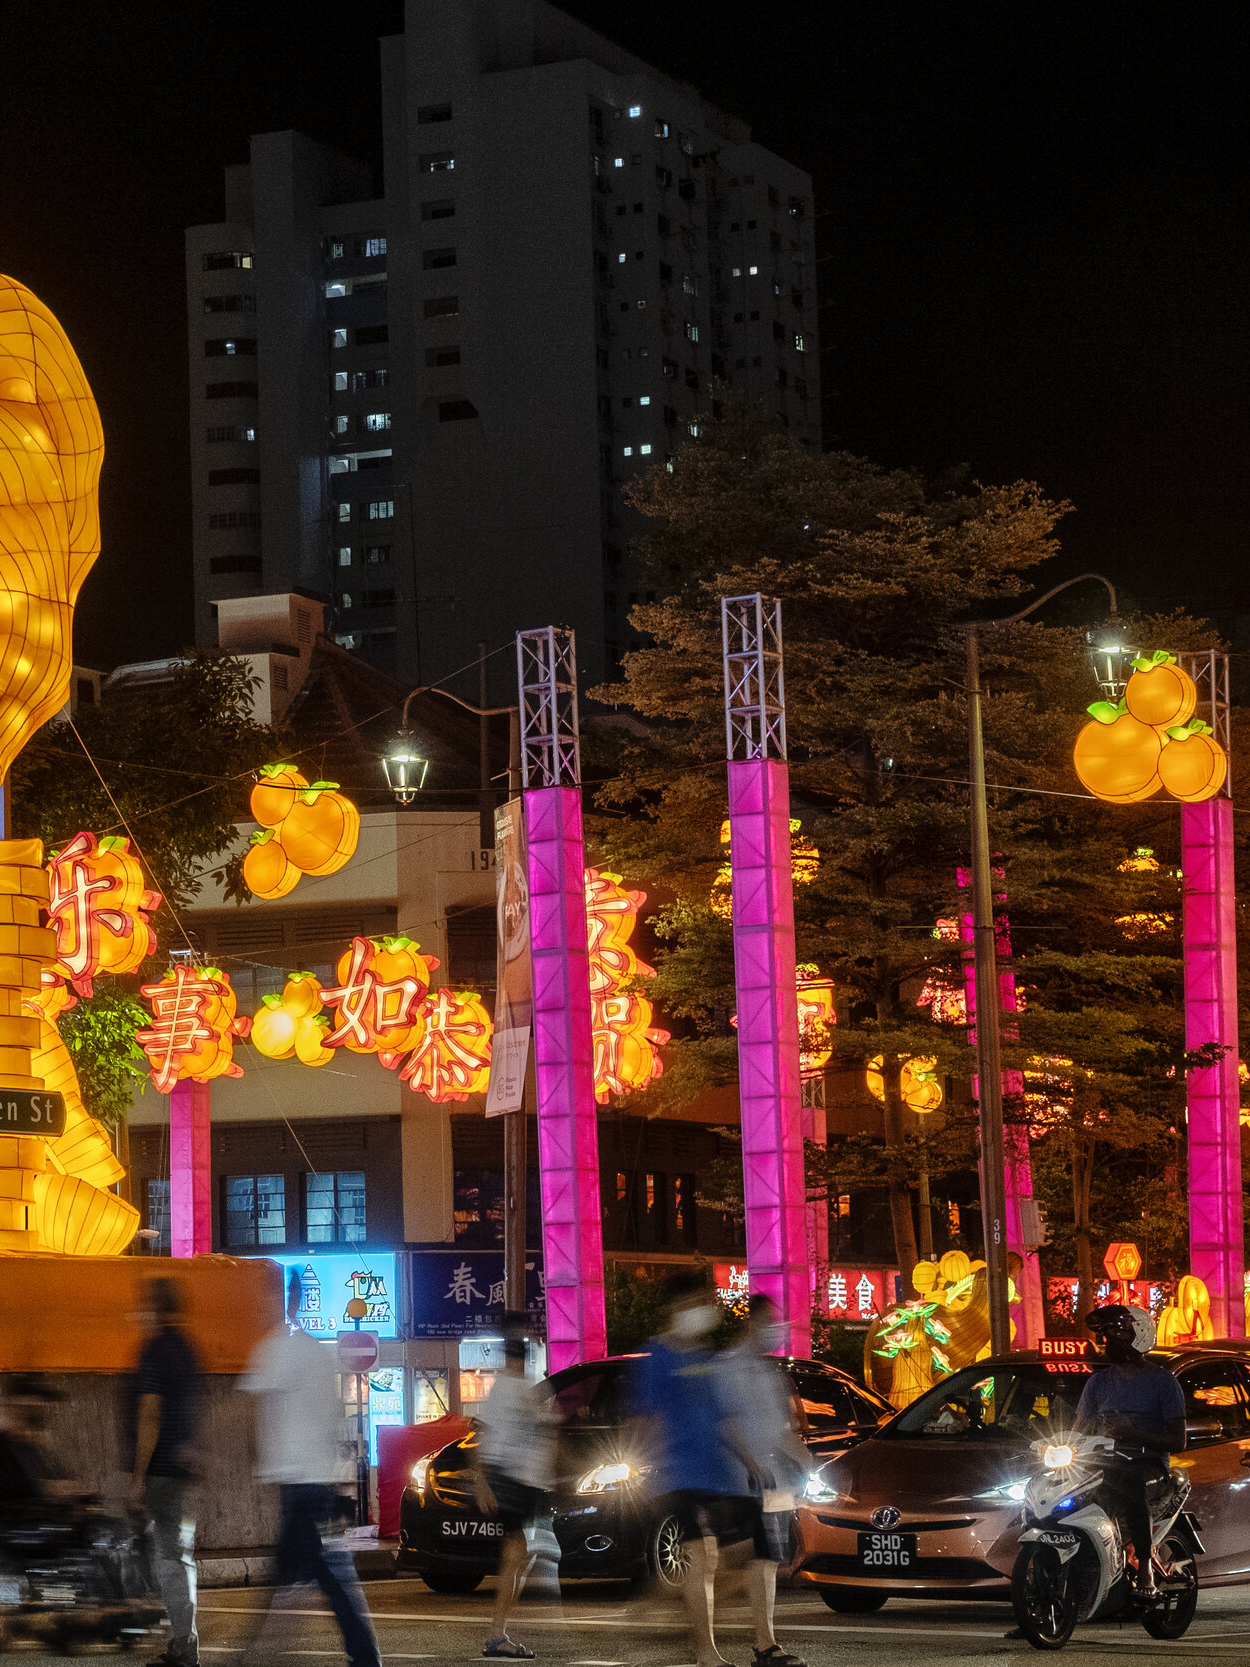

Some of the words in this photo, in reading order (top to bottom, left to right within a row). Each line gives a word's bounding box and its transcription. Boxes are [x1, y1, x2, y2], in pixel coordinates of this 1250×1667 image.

[319, 937, 427, 1047] 如
[136, 964, 230, 1093] 事
[399, 988, 491, 1103] 恭
[30, 1096, 53, 1124] St
[828, 1273, 875, 1311] 美食
[329, 1317, 337, 1331] 3
[1041, 1341, 1088, 1355] BUSY
[871, 1534, 901, 1550] SHD
